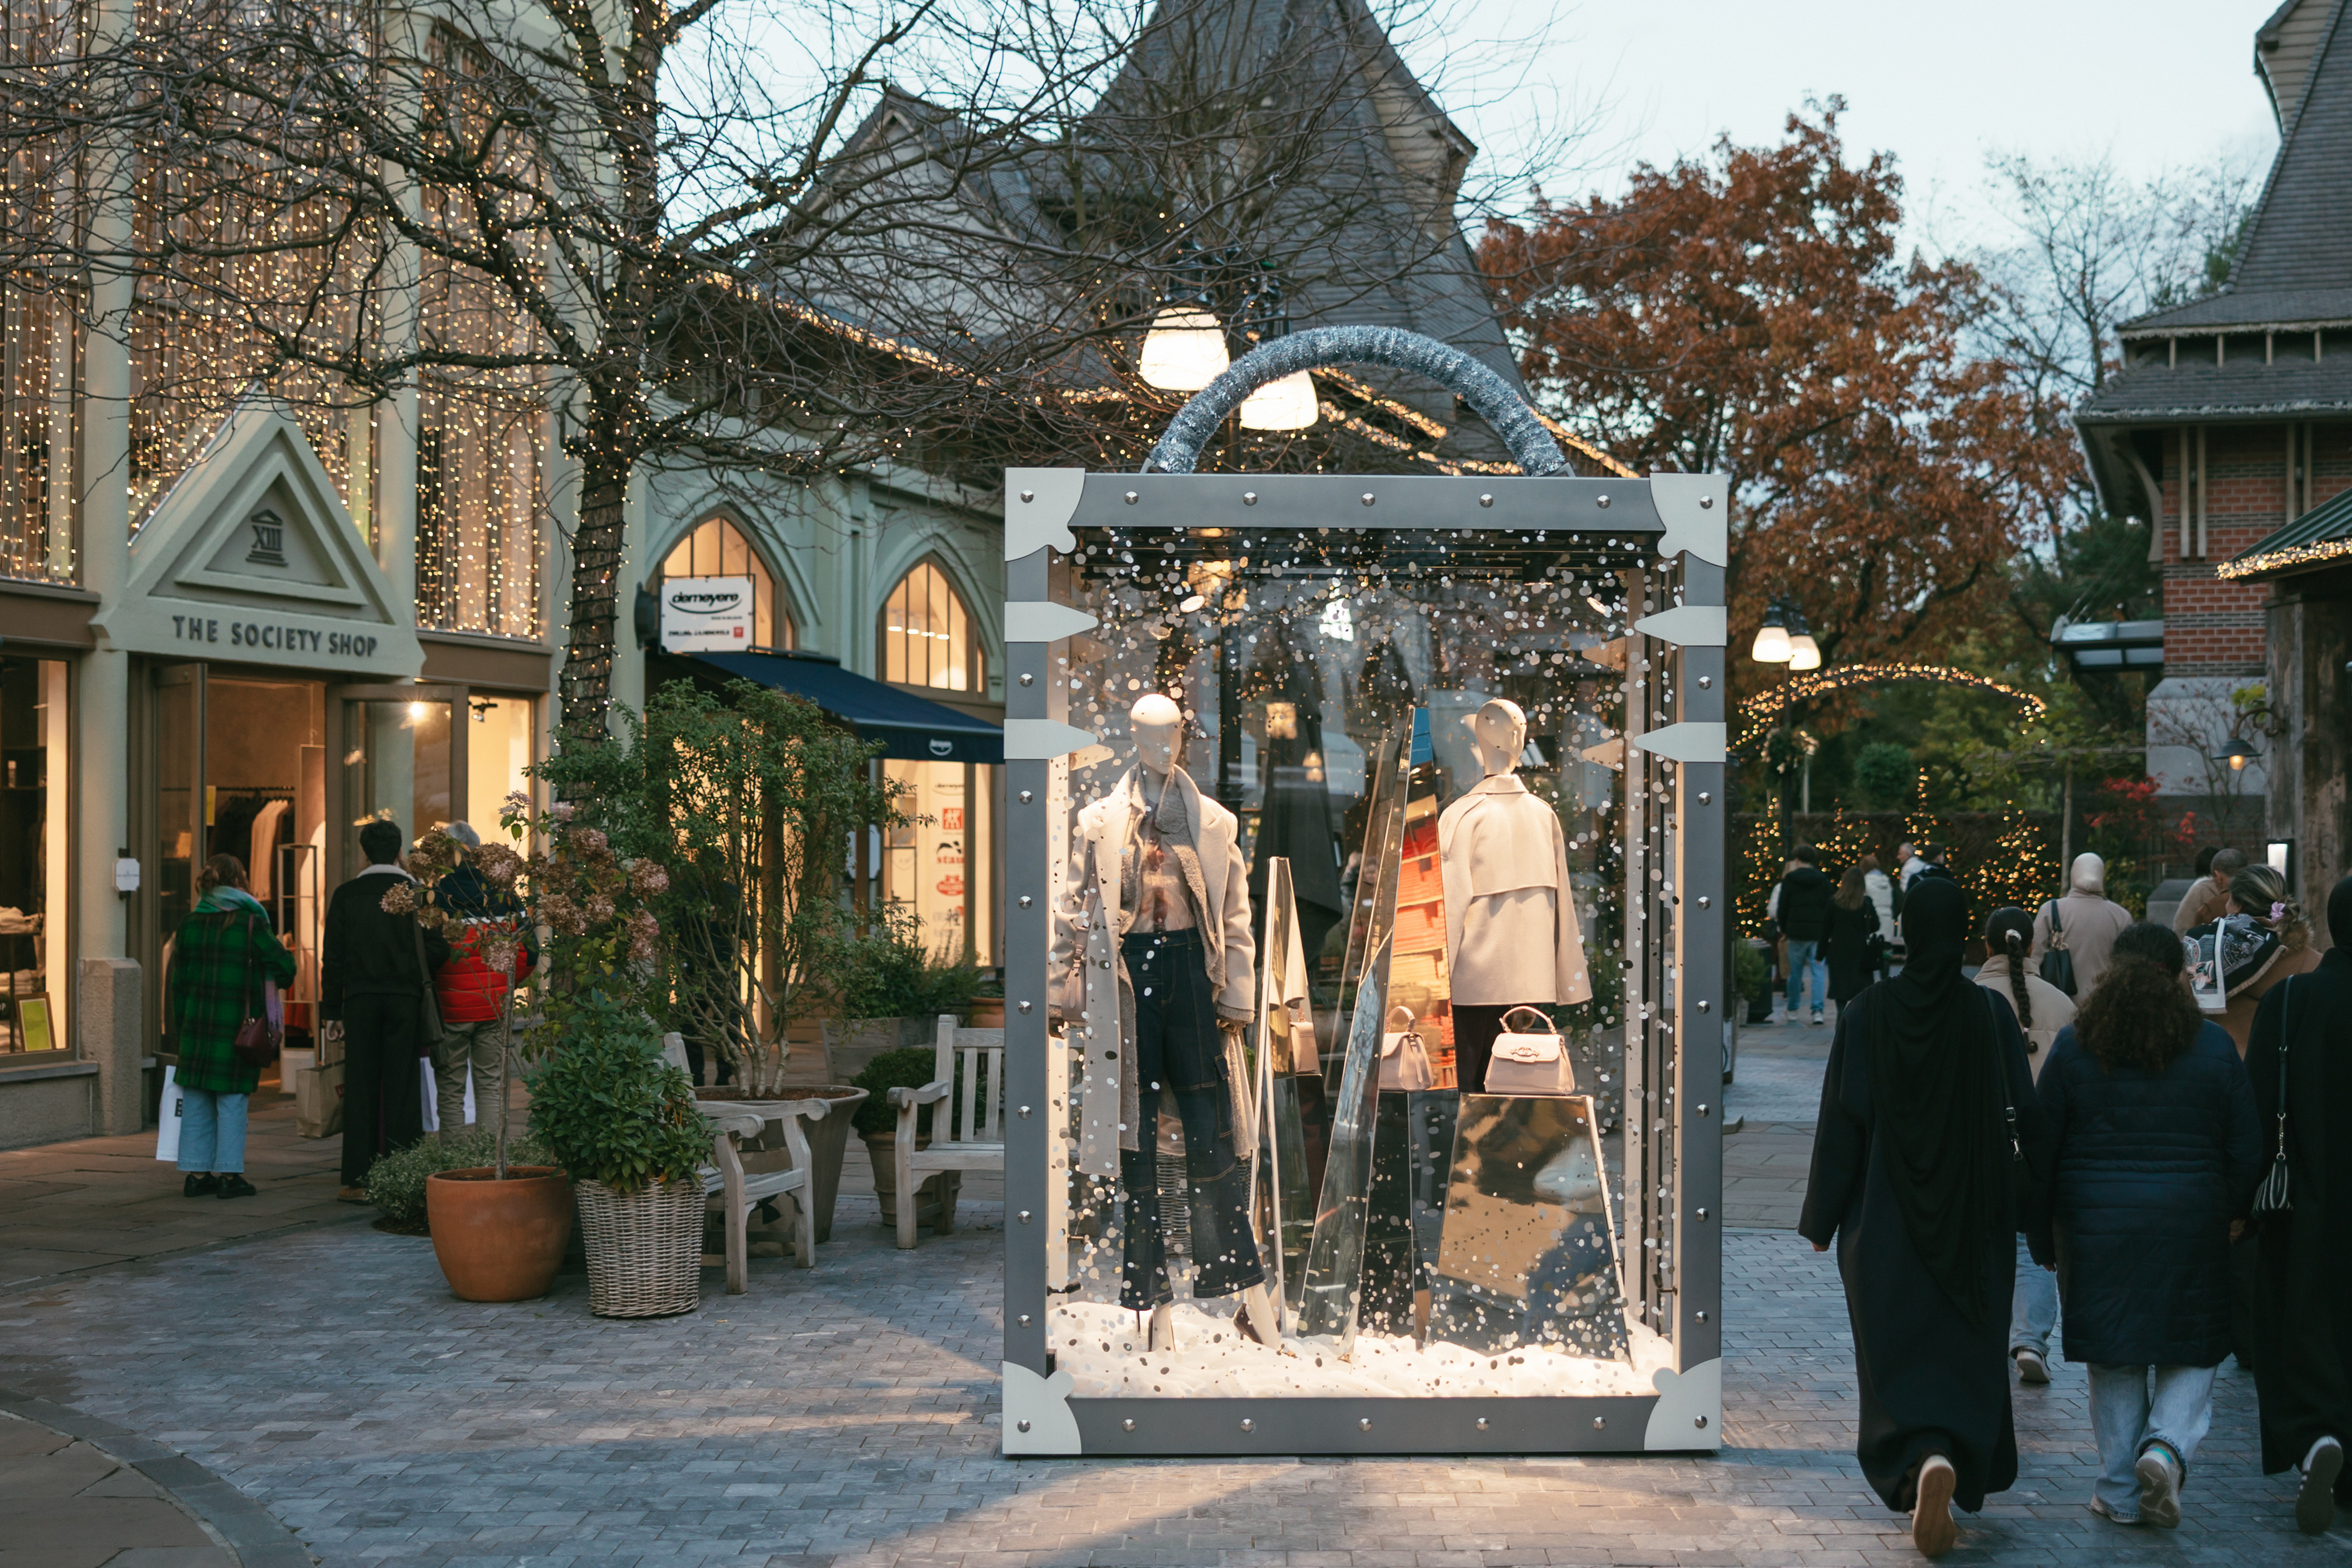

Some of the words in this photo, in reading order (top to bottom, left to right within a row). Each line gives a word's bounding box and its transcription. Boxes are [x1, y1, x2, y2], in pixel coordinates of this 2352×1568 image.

[672, 592, 739, 606] demeyere
[173, 616, 218, 642] THE
[232, 622, 323, 652] SOCIETY
[329, 632, 378, 657] SHOP
[937, 856, 965, 865] stau
